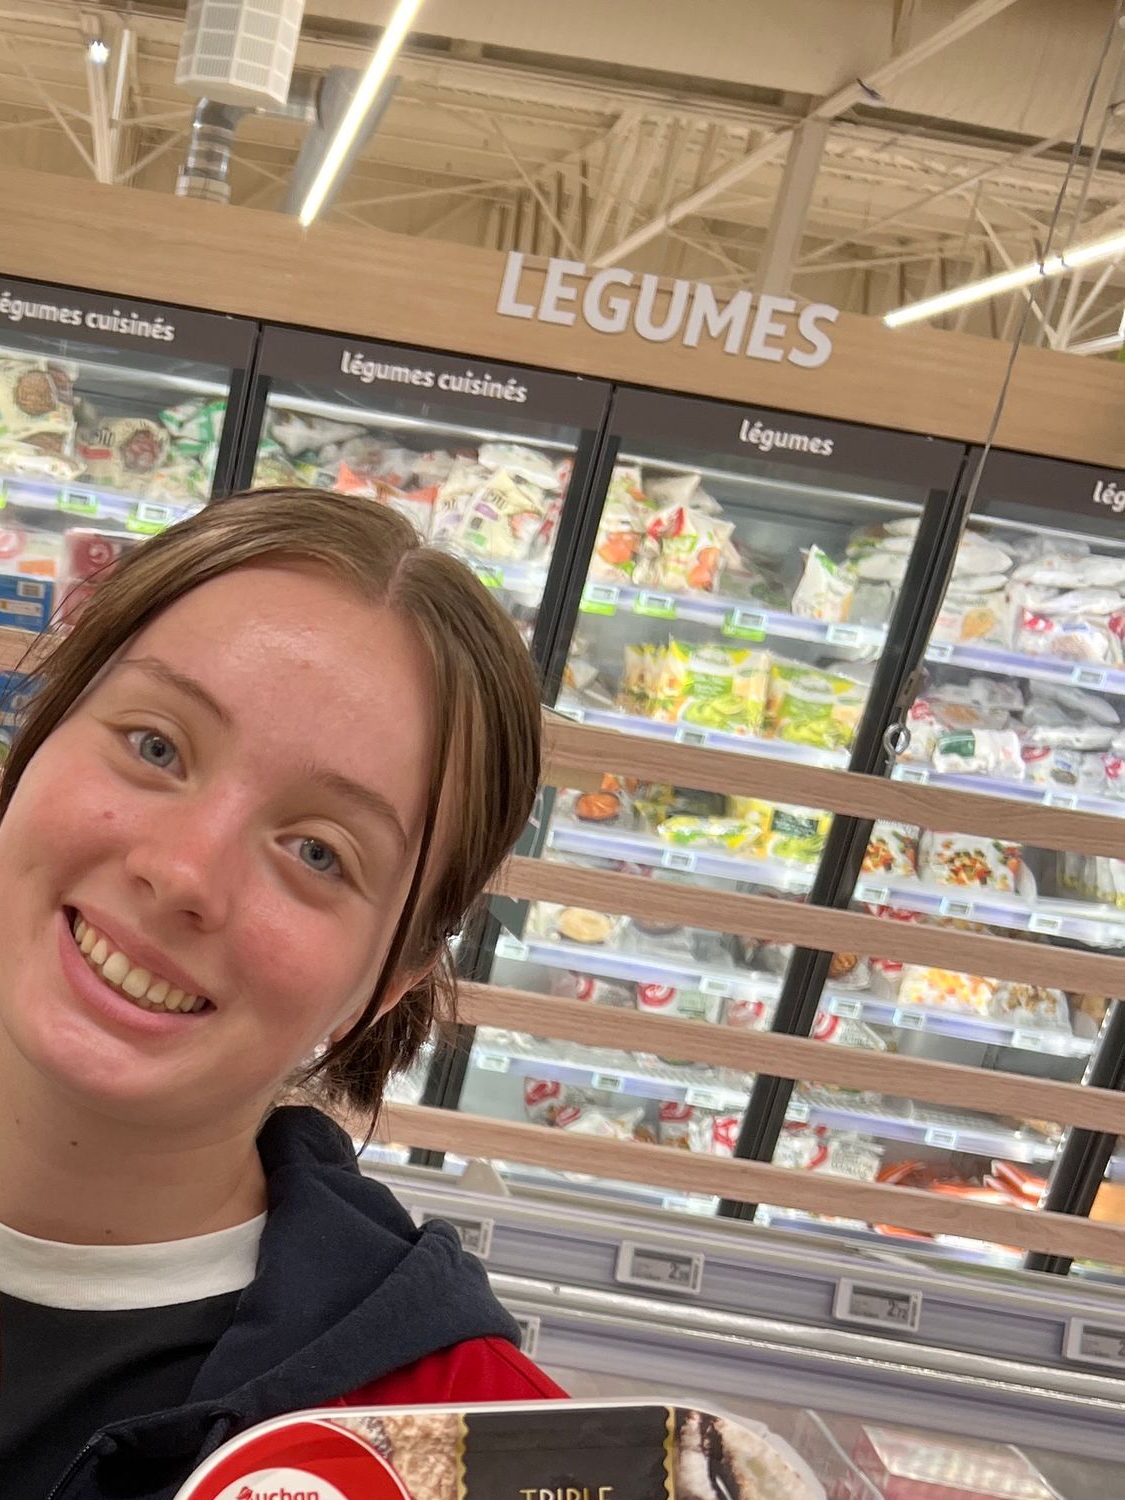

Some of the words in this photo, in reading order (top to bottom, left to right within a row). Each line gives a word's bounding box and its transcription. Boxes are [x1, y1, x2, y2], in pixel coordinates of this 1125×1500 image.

[85, 309, 175, 341] cuisinés
[497, 250, 840, 368] LEGUMES
[341, 350, 435, 388] légumes
[437, 370, 527, 403] cuisinés
[739, 419, 834, 456] légumes
